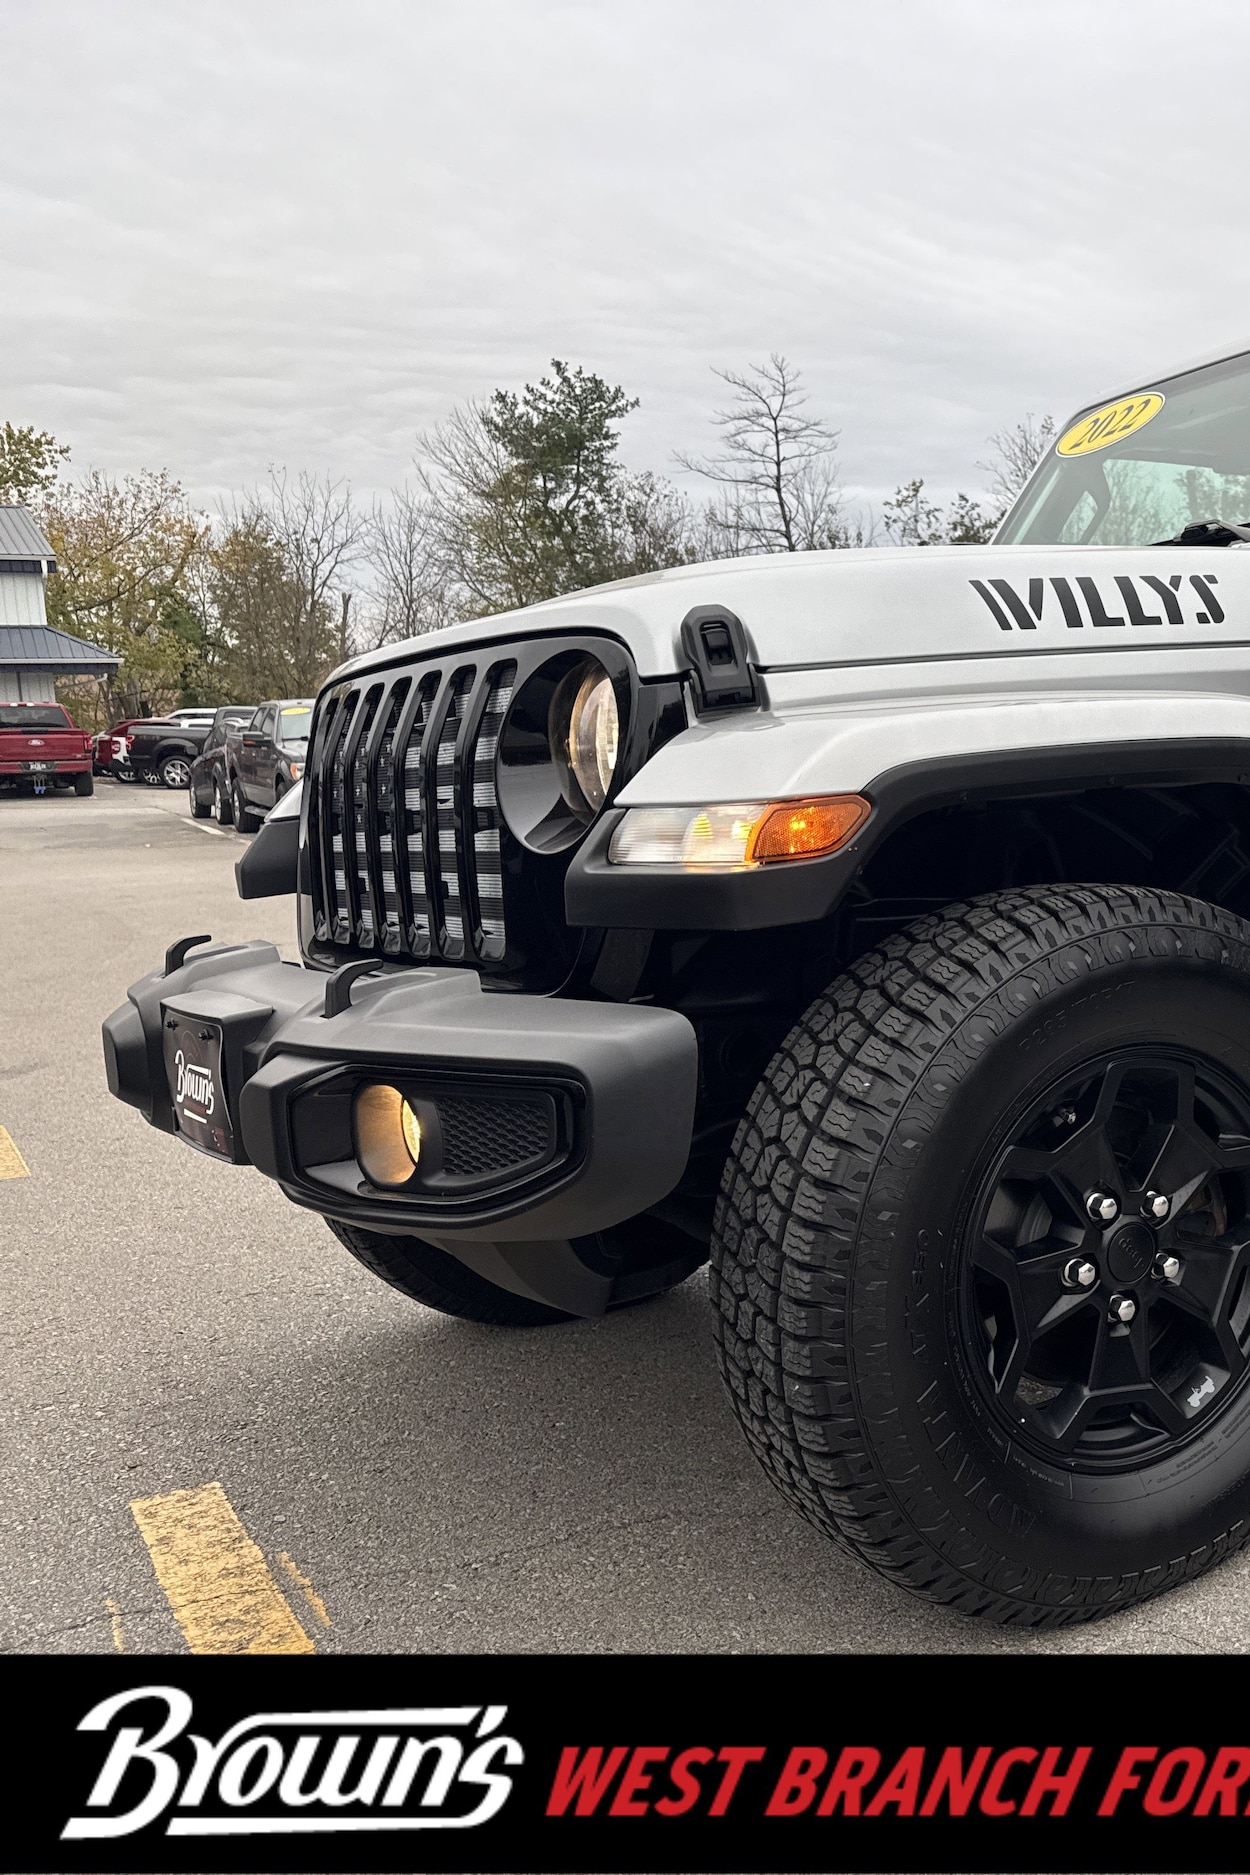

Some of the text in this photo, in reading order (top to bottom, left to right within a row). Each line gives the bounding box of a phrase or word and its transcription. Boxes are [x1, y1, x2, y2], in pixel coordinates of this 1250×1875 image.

[1068, 398, 1152, 451] 2022
[968, 574, 1225, 631] WILLYS
[174, 1050, 215, 1116] Brown's
